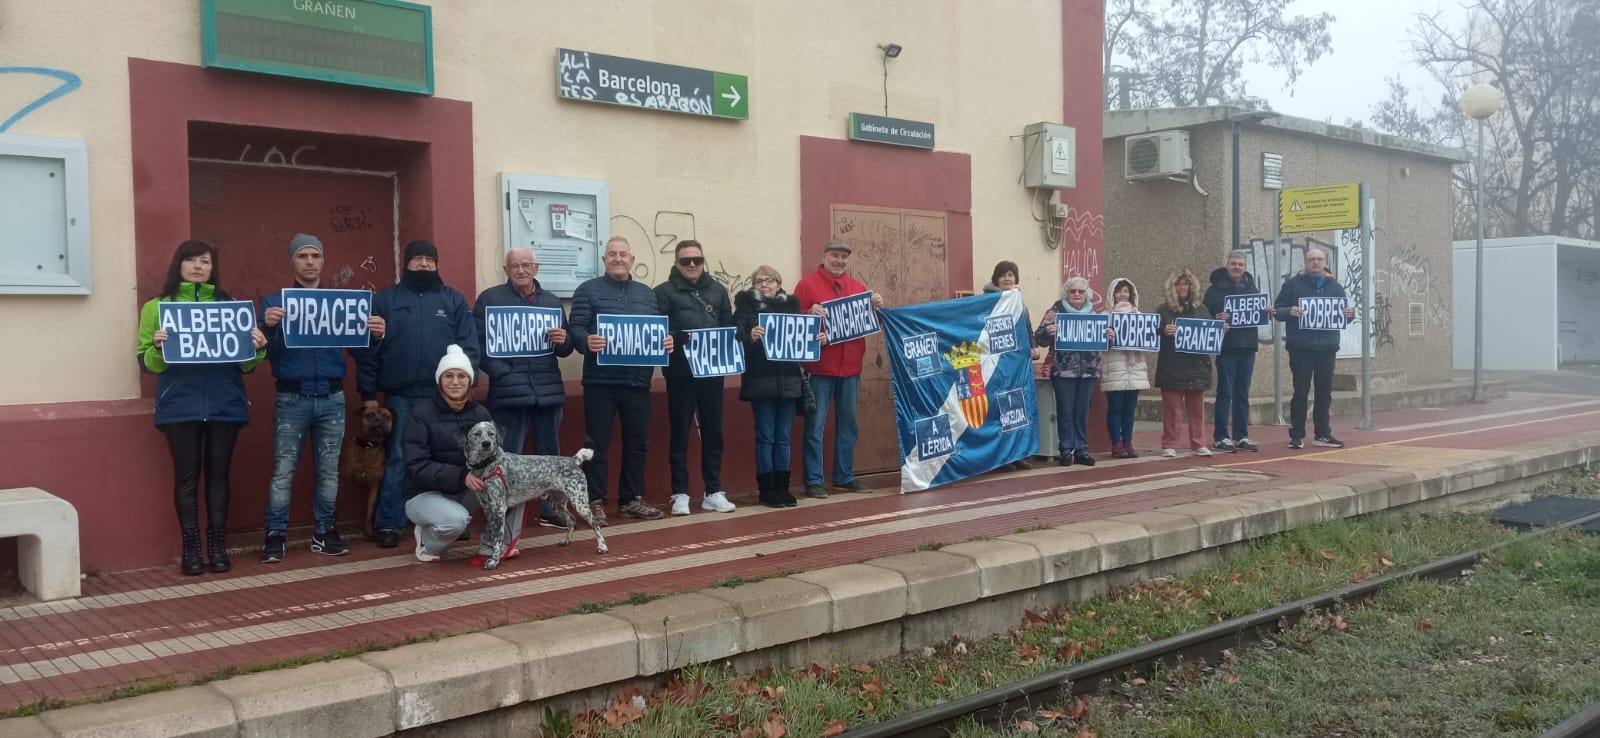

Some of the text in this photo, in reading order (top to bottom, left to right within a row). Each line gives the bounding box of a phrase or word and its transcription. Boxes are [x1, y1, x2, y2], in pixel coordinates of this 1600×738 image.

[599, 69, 681, 98] Barcelona
[860, 122, 932, 140] Gabinete de Circulación
[286, 297, 369, 337] PIRACES
[824, 297, 878, 342] SANGARREN
[1224, 297, 1267, 313] ALBERO
[1231, 310, 1260, 326] BAJO
[1301, 298, 1346, 329] ROBRES
[162, 307, 253, 334] ALBERO
[1056, 319, 1107, 343] ALMUNIENTE
[1113, 314, 1158, 348] ROBRES
[179, 332, 240, 359] BAJO
[599, 322, 666, 357] TRAMACED
[764, 315, 815, 360] CURBE
[1174, 321, 1224, 351] GRAÑÉN
[932, 419, 940, 436] A
